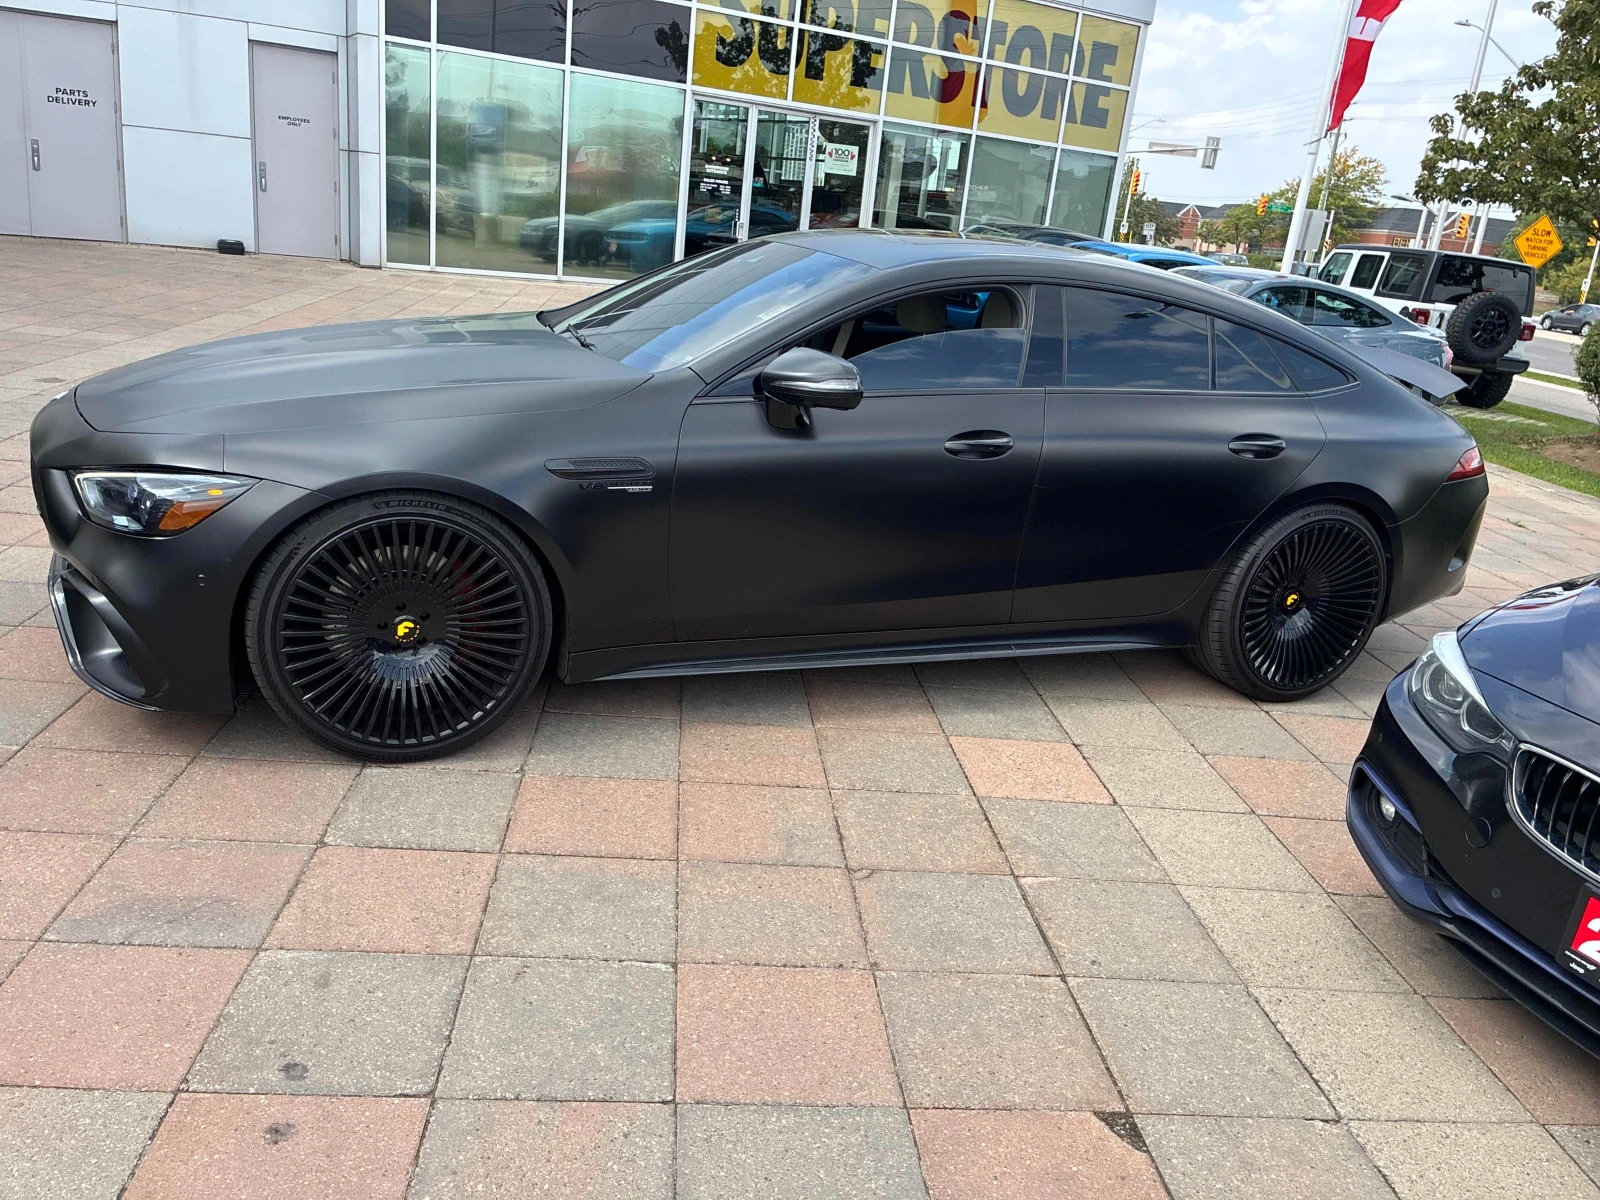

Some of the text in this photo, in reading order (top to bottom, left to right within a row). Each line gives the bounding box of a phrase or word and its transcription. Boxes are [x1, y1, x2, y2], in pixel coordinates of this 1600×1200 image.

[715, 0, 1119, 129] SUPERSTORE
[55, 87, 89, 98] PARTS
[47, 95, 98, 107] DELIVERY
[278, 115, 310, 123] EMPLOYEES
[834, 147, 850, 157] 100
[1532, 228, 1552, 237] SLOW
[1527, 244, 1548, 252] TURNING
[1524, 251, 1548, 260] VEHICLES
[577, 481, 605, 490] V8
[389, 500, 447, 511] MICHELIN
[1287, 594, 1297, 605] F
[397, 621, 415, 636] F
